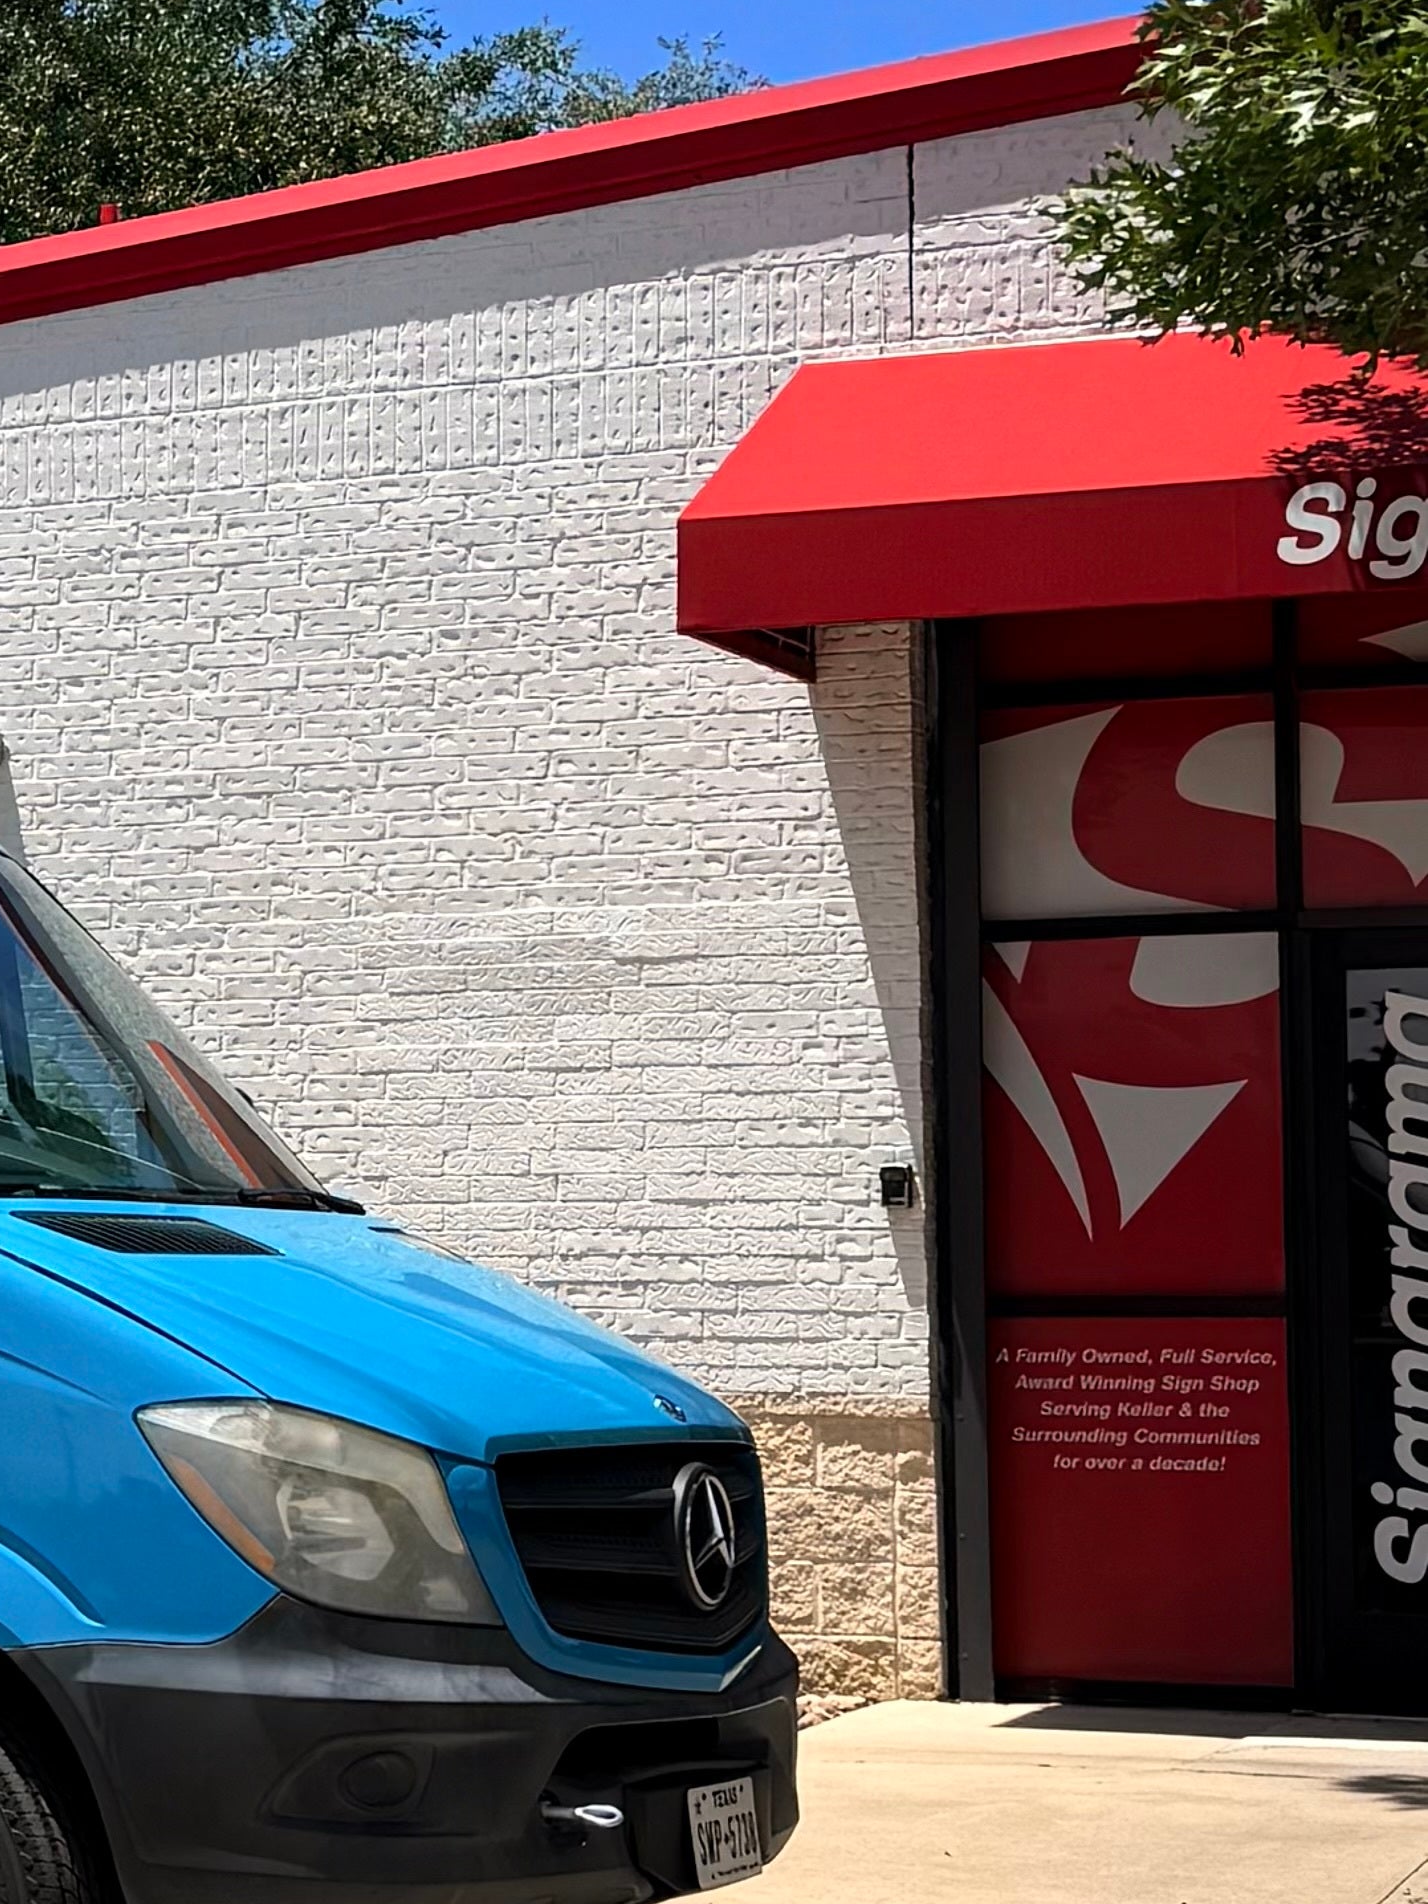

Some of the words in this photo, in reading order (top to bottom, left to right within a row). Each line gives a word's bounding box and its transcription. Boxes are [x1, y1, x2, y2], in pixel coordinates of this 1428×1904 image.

[996, 1348, 1008, 1363] A
[1016, 1348, 1075, 1365] Family
[1082, 1349, 1152, 1365] Owned,
[1160, 1349, 1195, 1364] Full
[1200, 1349, 1277, 1366] Service,
[1015, 1375, 1074, 1390] Award
[1080, 1375, 1155, 1393] Winning
[1161, 1375, 1204, 1394] Sign
[1210, 1376, 1260, 1394] Shop
[1040, 1401, 1111, 1420] Serving
[1117, 1401, 1174, 1417] Keller
[1179, 1402, 1192, 1417] &
[1199, 1402, 1230, 1418] the
[1012, 1427, 1127, 1446] Surrounding
[1134, 1428, 1261, 1445] Communities
[1054, 1454, 1079, 1469] for
[1085, 1457, 1126, 1470] over
[1131, 1458, 1143, 1470] a
[1149, 1456, 1226, 1472] decade!
